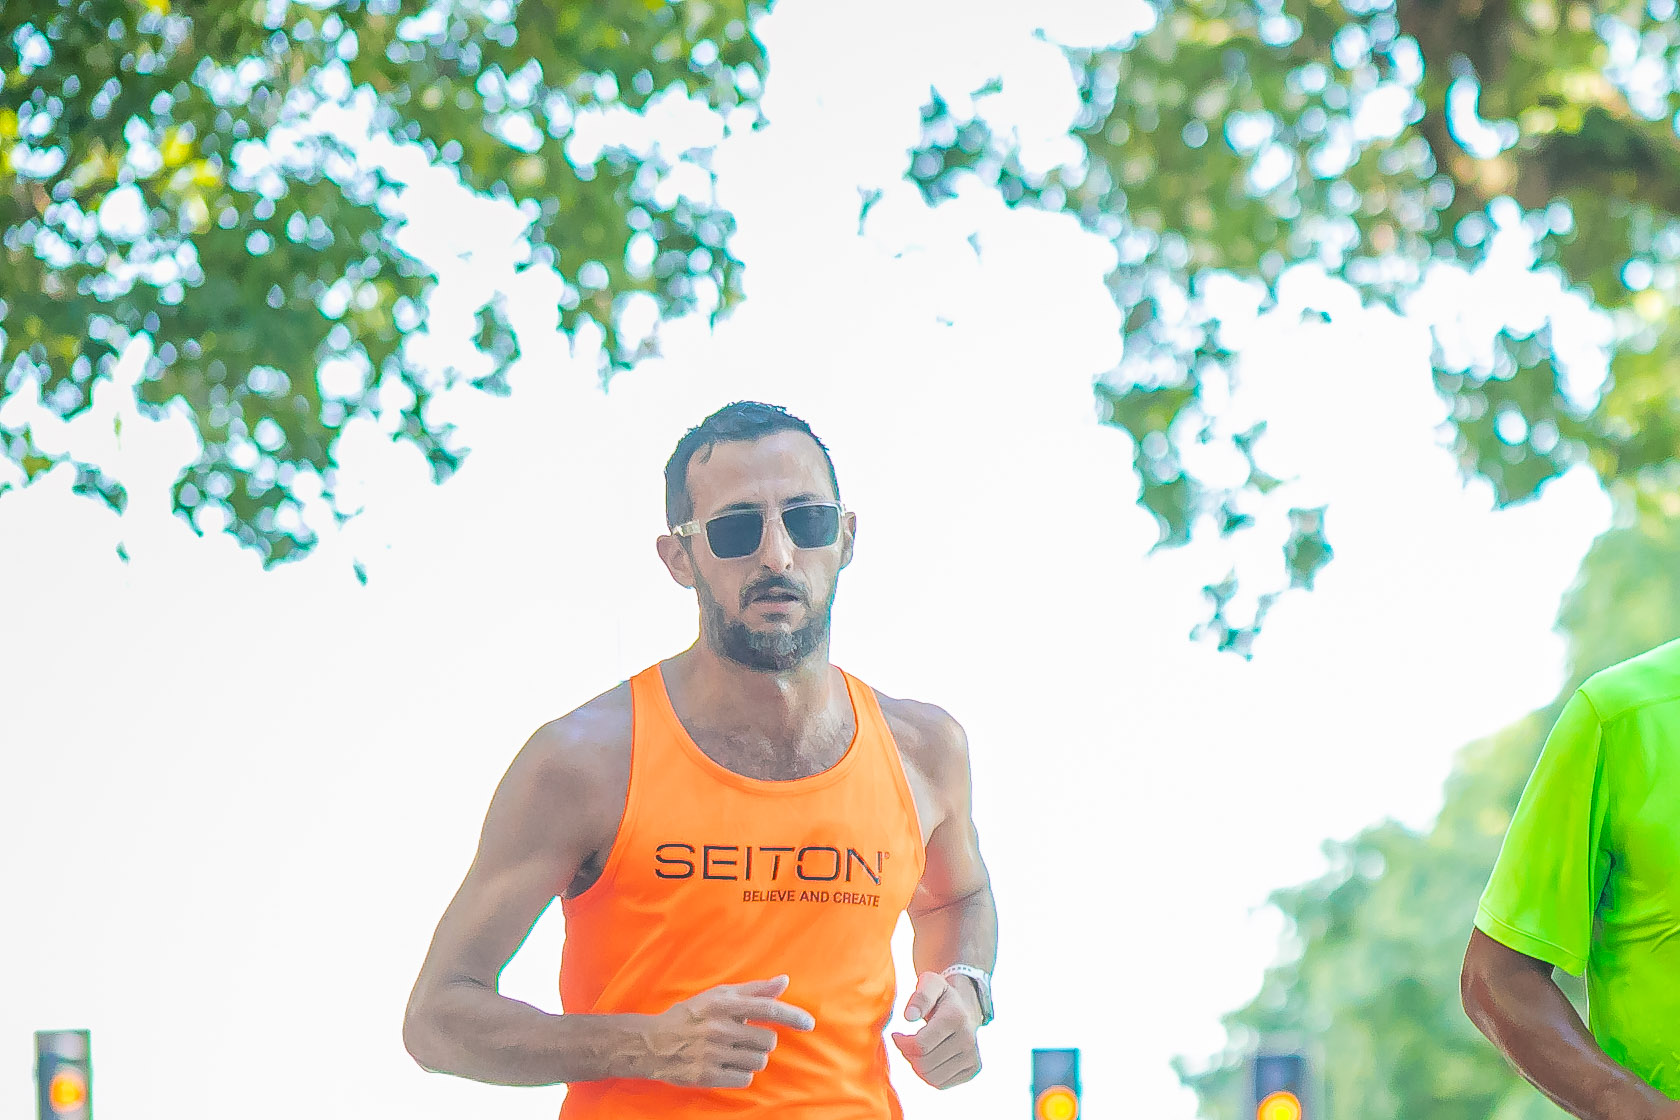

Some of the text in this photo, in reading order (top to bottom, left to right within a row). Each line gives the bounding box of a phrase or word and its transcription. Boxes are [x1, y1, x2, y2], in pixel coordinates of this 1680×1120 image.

[655, 843, 882, 885] SEITON
[742, 889, 881, 908] BELIEVE AND CREATE
